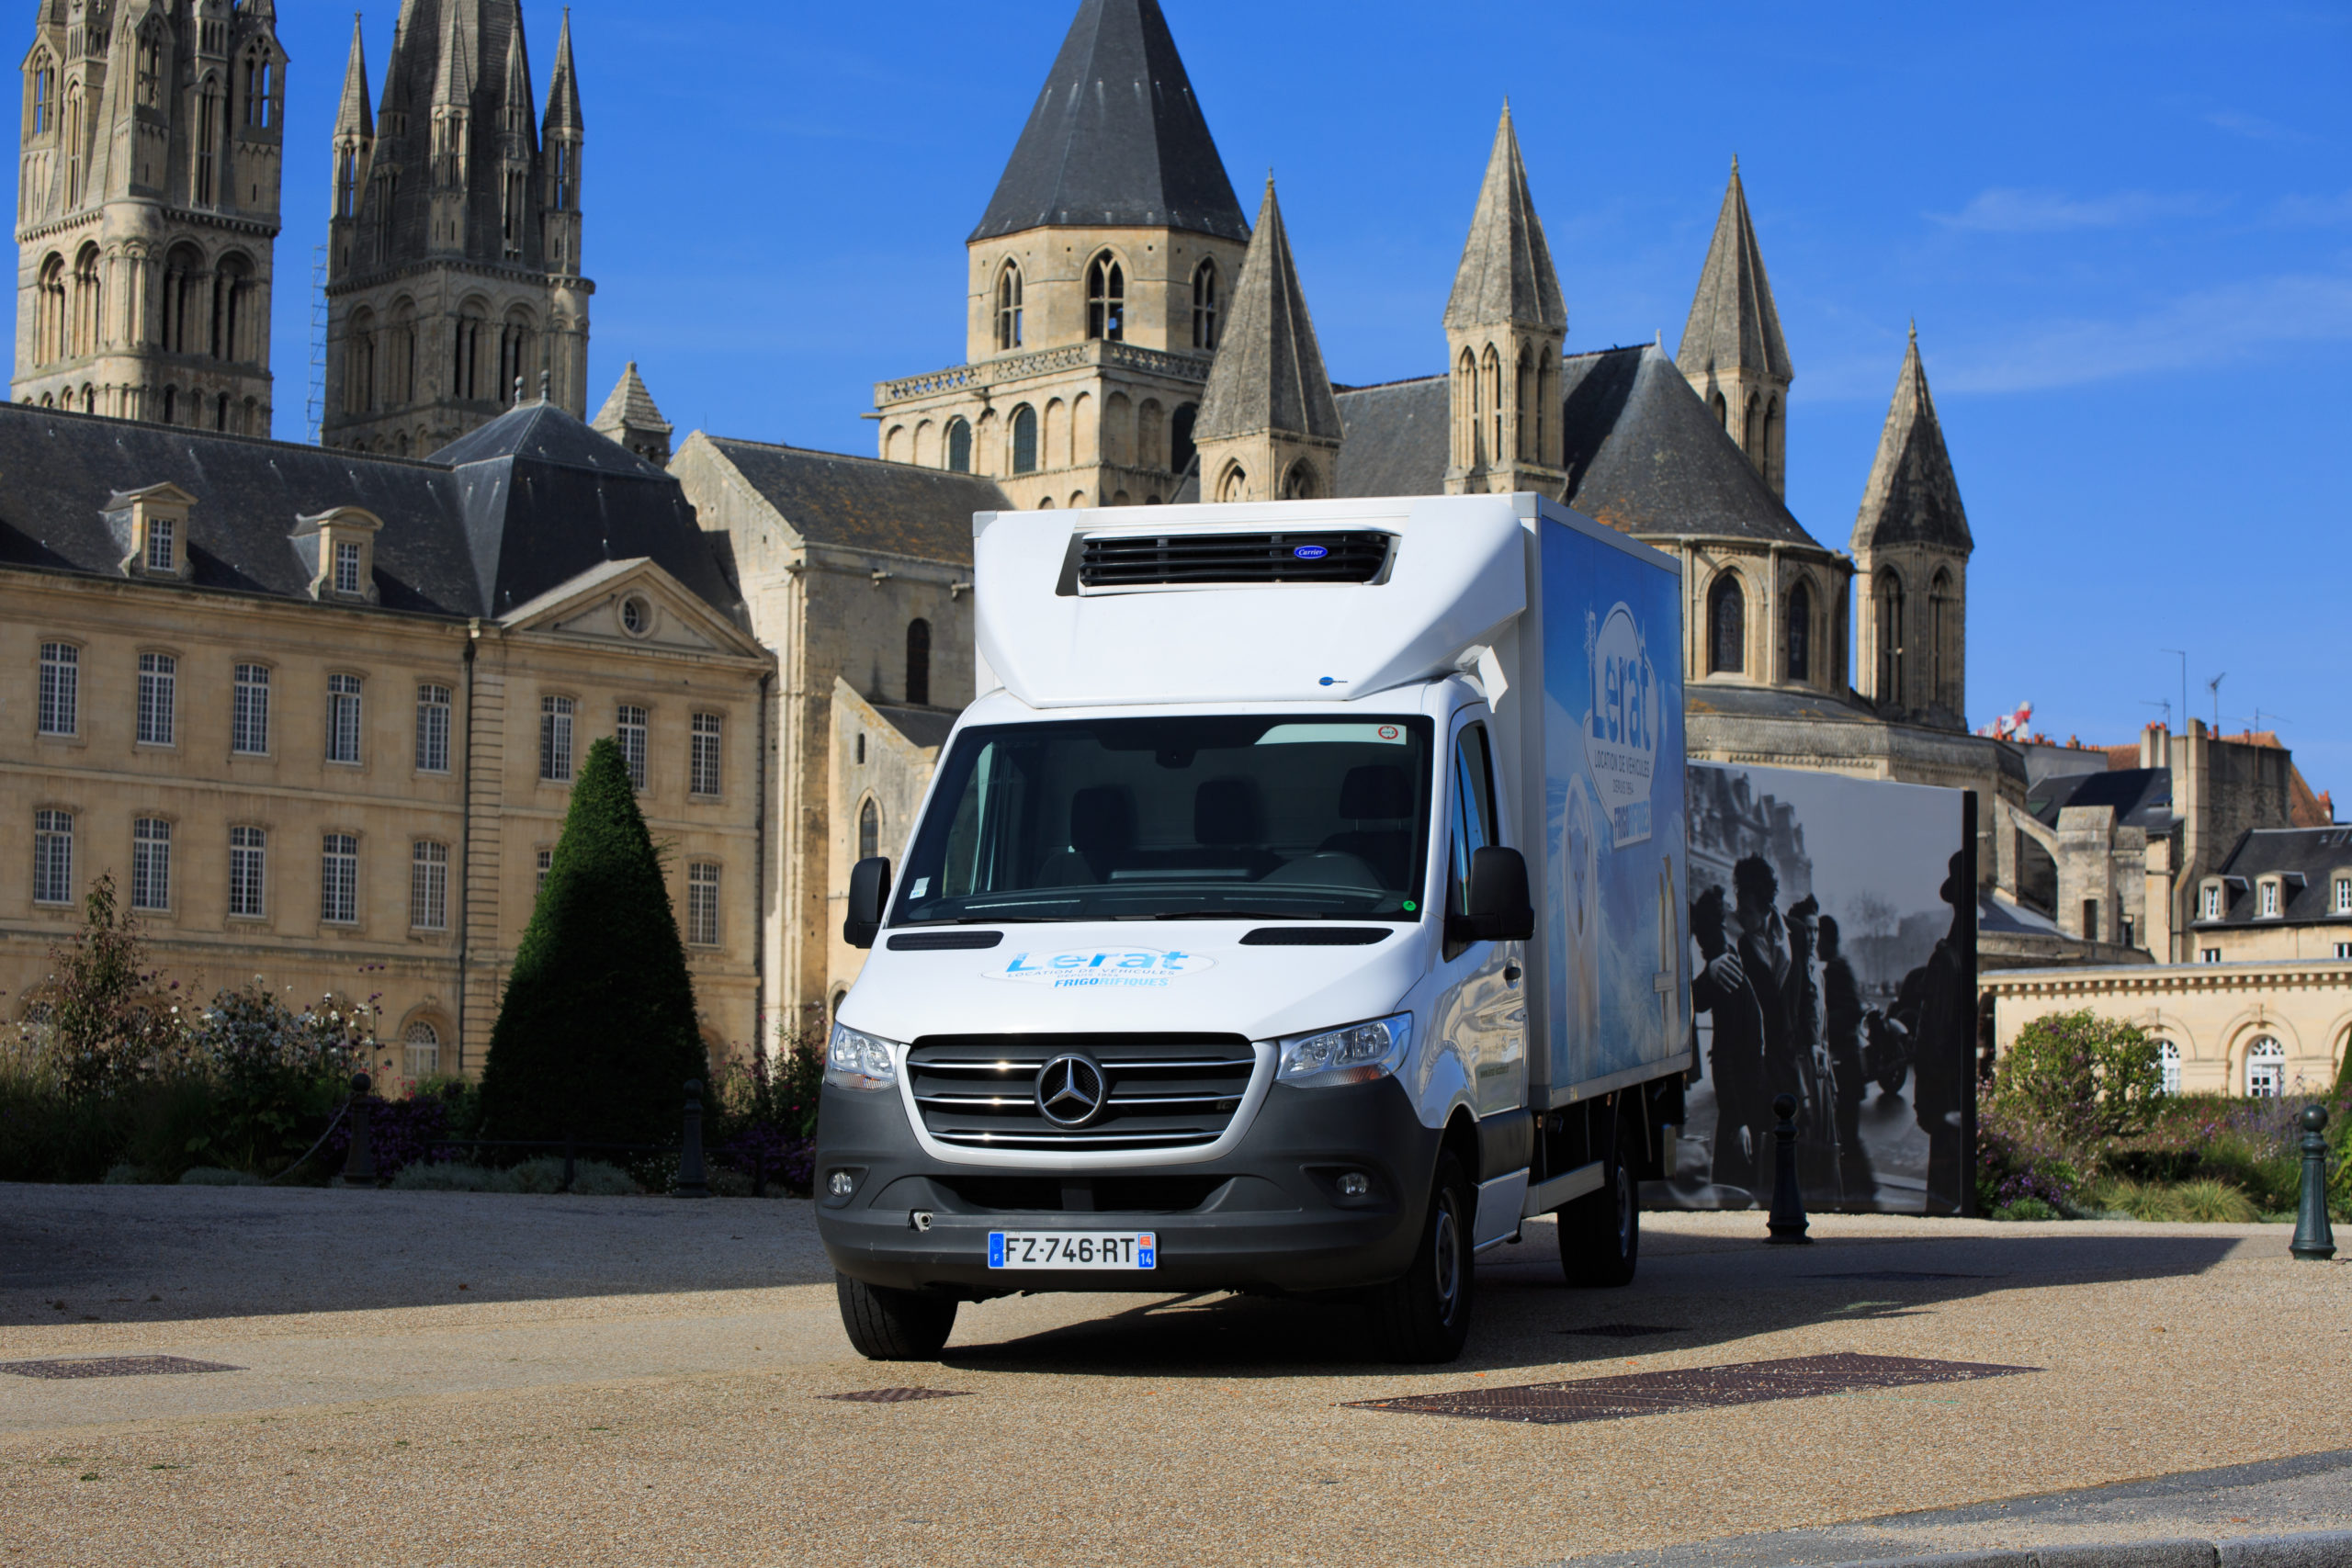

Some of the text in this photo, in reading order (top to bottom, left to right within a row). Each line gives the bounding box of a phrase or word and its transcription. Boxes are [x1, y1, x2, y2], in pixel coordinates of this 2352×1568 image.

[1589, 609, 1652, 752] Lerat
[1618, 753, 1625, 773] DE
[1005, 951, 1190, 973] Lerat
[1007, 968, 1073, 978] LOCATION
[1054, 977, 1170, 987] FRIGORIFIQUES
[993, 1254, 1000, 1262] F
[1005, 1237, 1136, 1263] FZ-746-RT
[1140, 1252, 1152, 1265] 14
